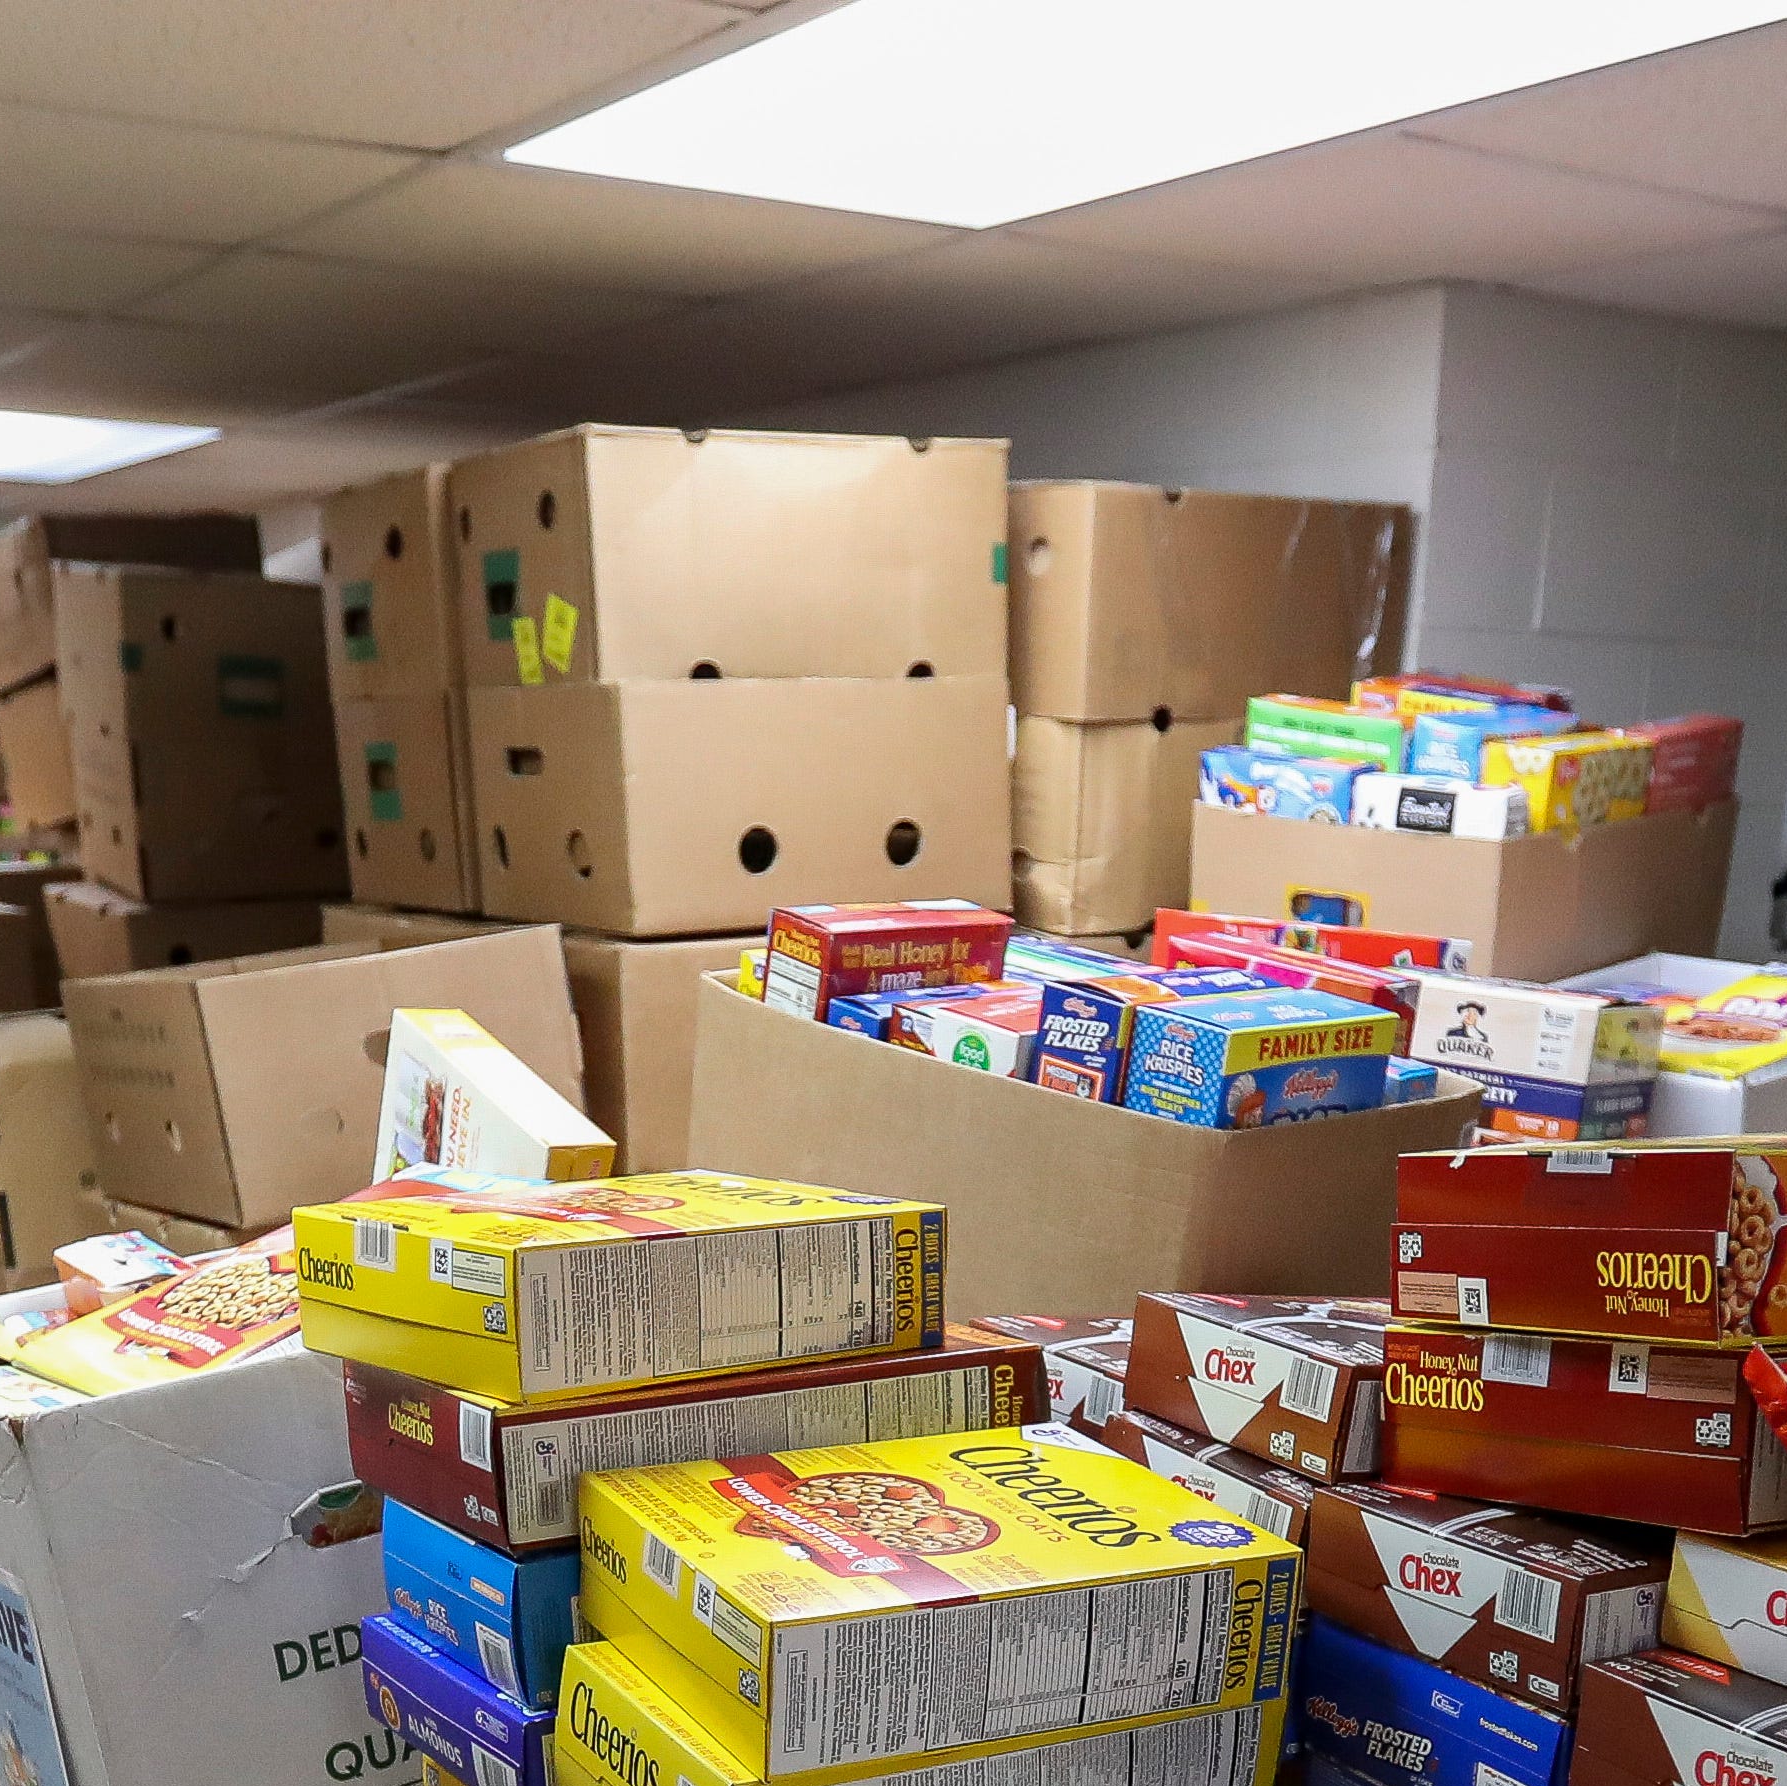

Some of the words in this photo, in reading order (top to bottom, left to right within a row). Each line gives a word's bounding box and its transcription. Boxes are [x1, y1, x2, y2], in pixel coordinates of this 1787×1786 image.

[1043, 1015, 1109, 1038] FROSTED
[1044, 1032, 1101, 1052] FLAKES
[1258, 1036, 1328, 1062] FAMILY
[1334, 1027, 1373, 1051] SIZE
[1145, 1054, 1204, 1085] KRISPIES
[1161, 1040, 1195, 1063] RICE
[1435, 1038, 1494, 1062] QUAKER
[298, 1246, 355, 1292] Cheerios
[895, 1228, 921, 1333] Cheerios
[1597, 1249, 1713, 1296] Cheerios
[1629, 1293, 1671, 1320] Honey
[1204, 1349, 1256, 1387] Chex
[1419, 1350, 1455, 1377] Honey
[1457, 1354, 1479, 1374] Nut
[1385, 1363, 1484, 1413] Cheerios
[388, 1404, 434, 1447] Cheerios
[949, 1446, 1164, 1549] Cheerios
[727, 1477, 765, 1509] LOWER
[763, 1502, 863, 1562] CHOLESTEROL
[581, 1515, 628, 1586] Cheerios
[1421, 1551, 1461, 1572] Chocolate
[1398, 1553, 1463, 1599] Chex
[1224, 1578, 1264, 1692] Cheerios
[407, 1713, 463, 1769] ALMONDS
[1306, 1696, 1360, 1738] Kellogg's
[1363, 1719, 1432, 1757] FROSTED
[1366, 1739, 1426, 1773] FLAKES
[1725, 1749, 1775, 1776] Chocolate
